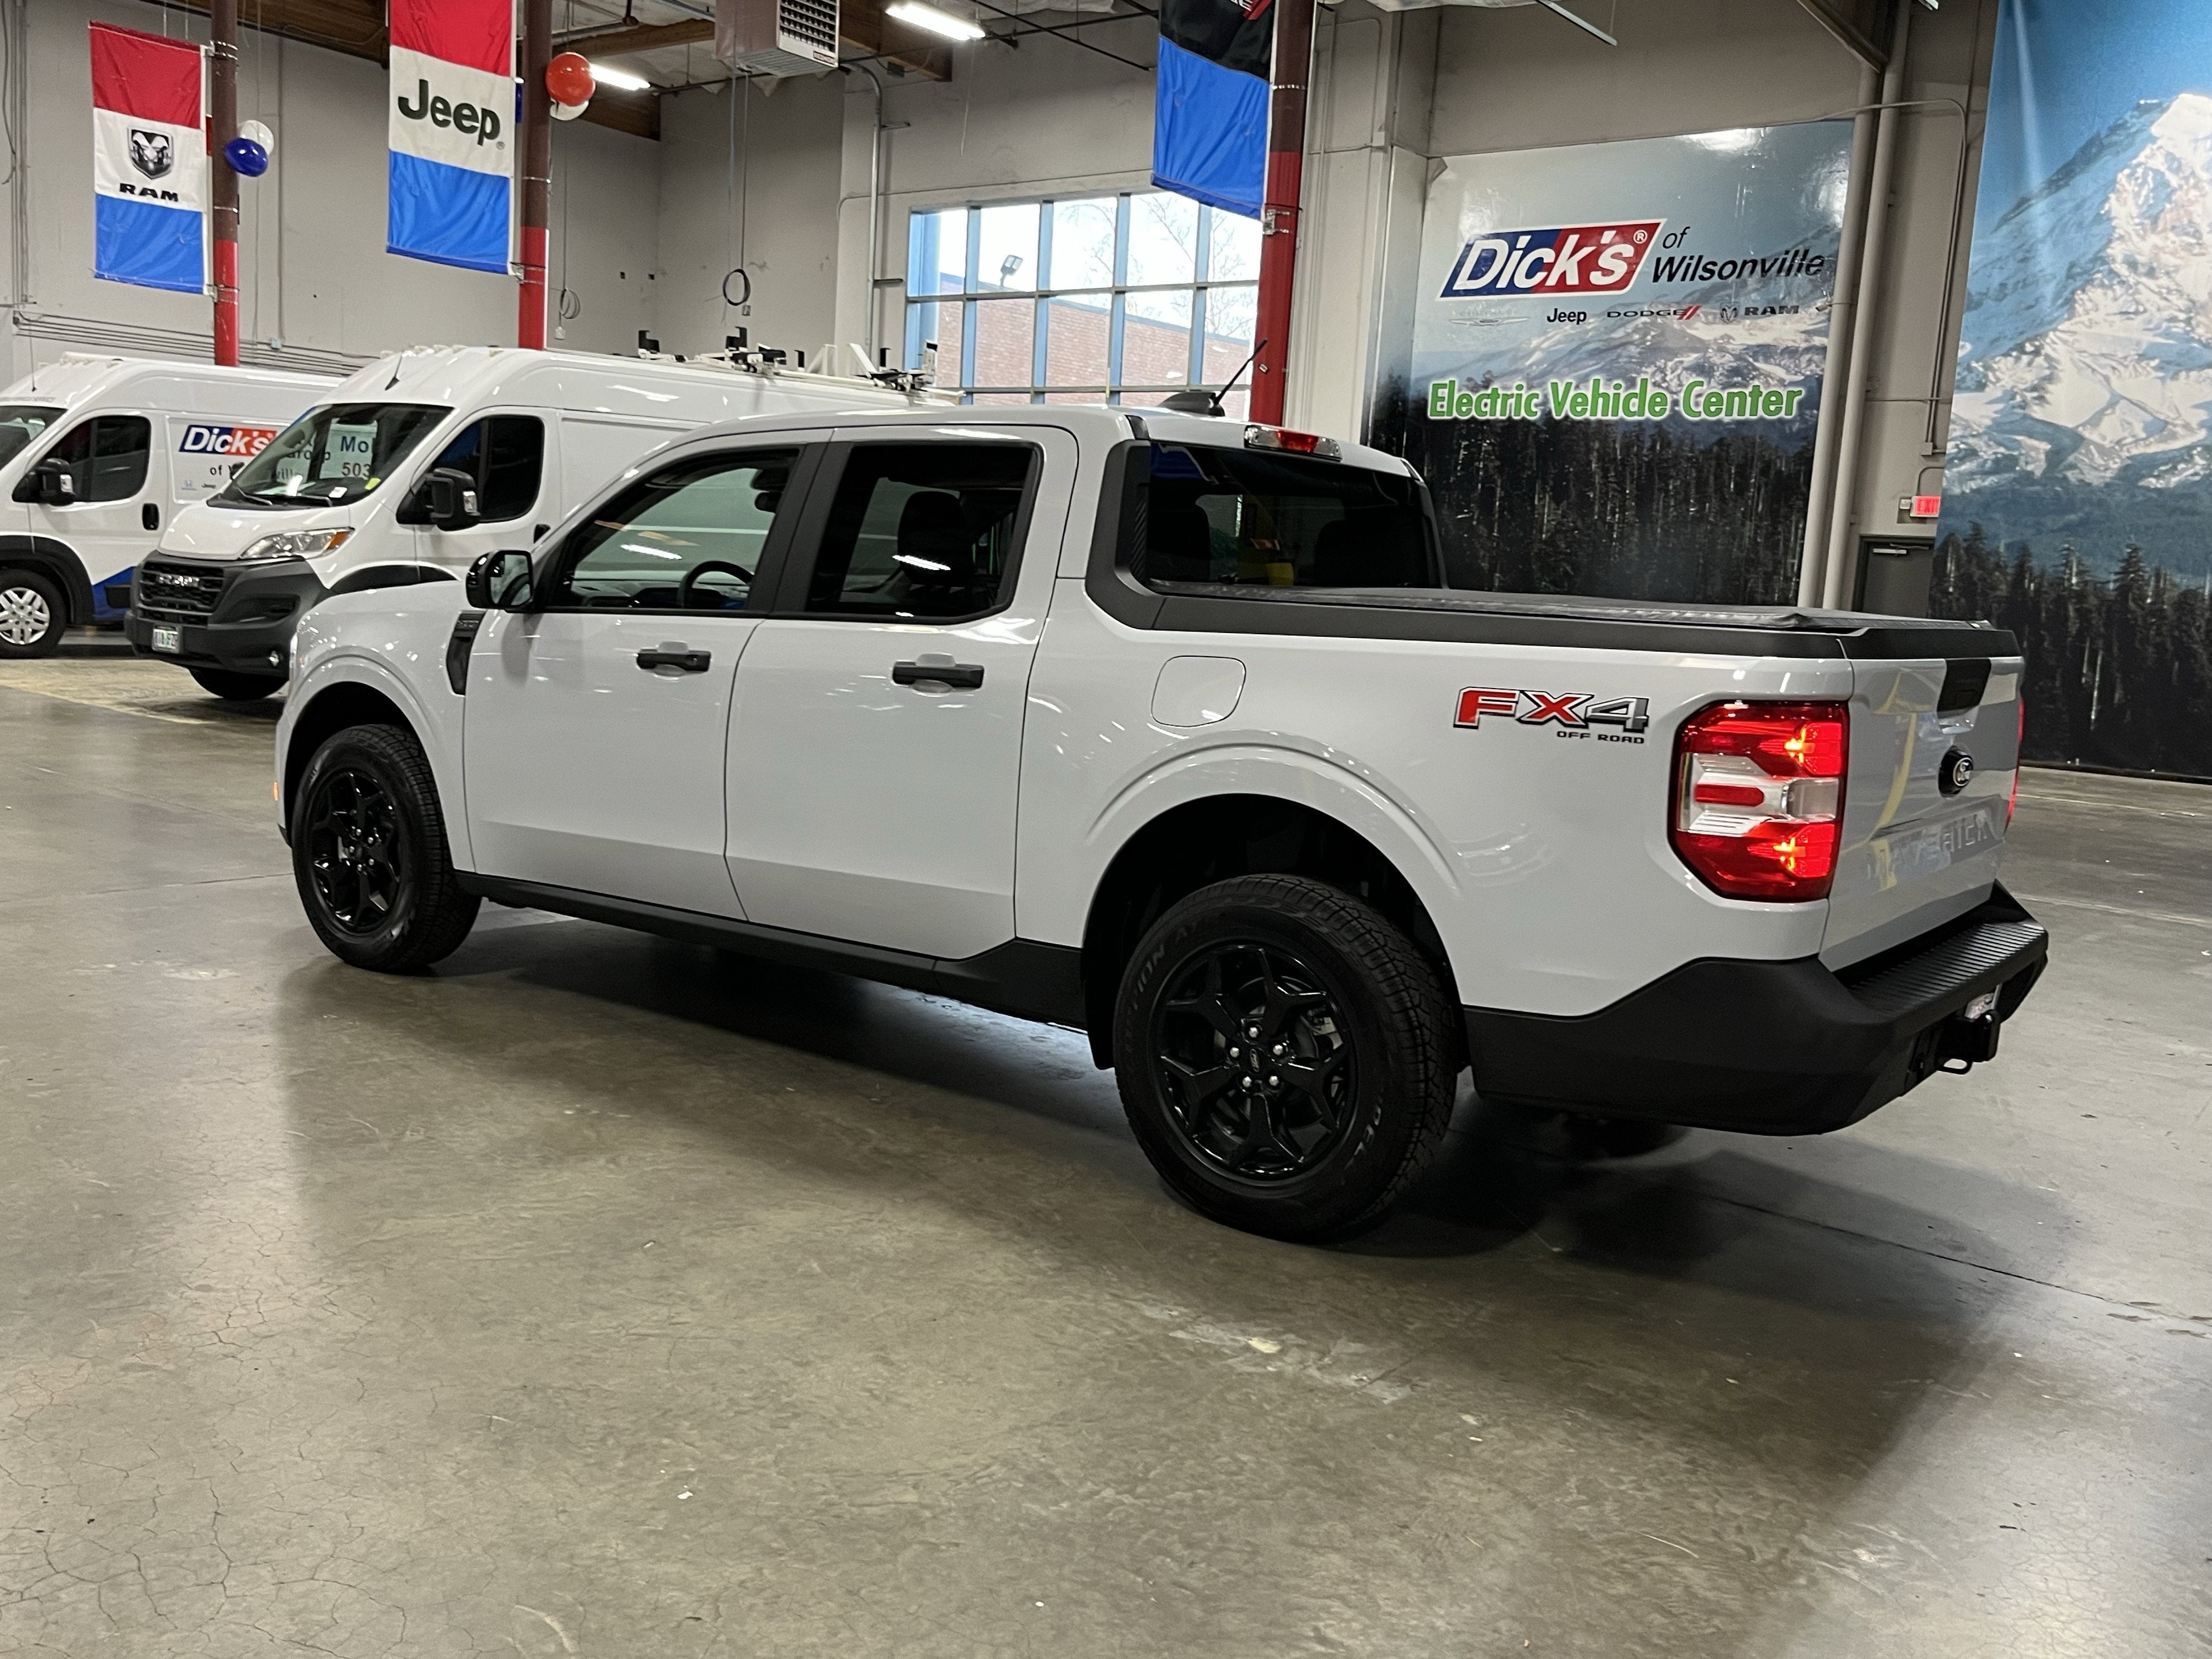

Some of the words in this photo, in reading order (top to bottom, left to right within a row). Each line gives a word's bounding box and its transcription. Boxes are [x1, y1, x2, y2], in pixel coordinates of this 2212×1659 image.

[397, 78, 501, 146] Jeep
[120, 183, 178, 202] RAM
[1452, 230, 1635, 290] Dick's
[1662, 226, 1691, 249] of
[1652, 248, 1825, 283] Wilsonville
[1547, 308, 1587, 325] Jeep
[1606, 309, 1686, 318] DODGE
[1744, 305, 1799, 316] RAM
[1429, 380, 1540, 418] Electric
[1549, 377, 1669, 418] Vehicle
[1681, 380, 1803, 418] Center
[210, 465, 222, 476] of
[1453, 686, 1650, 733] FX4
[1556, 730, 1591, 740] OFF
[1597, 733, 1645, 744] ROAD
